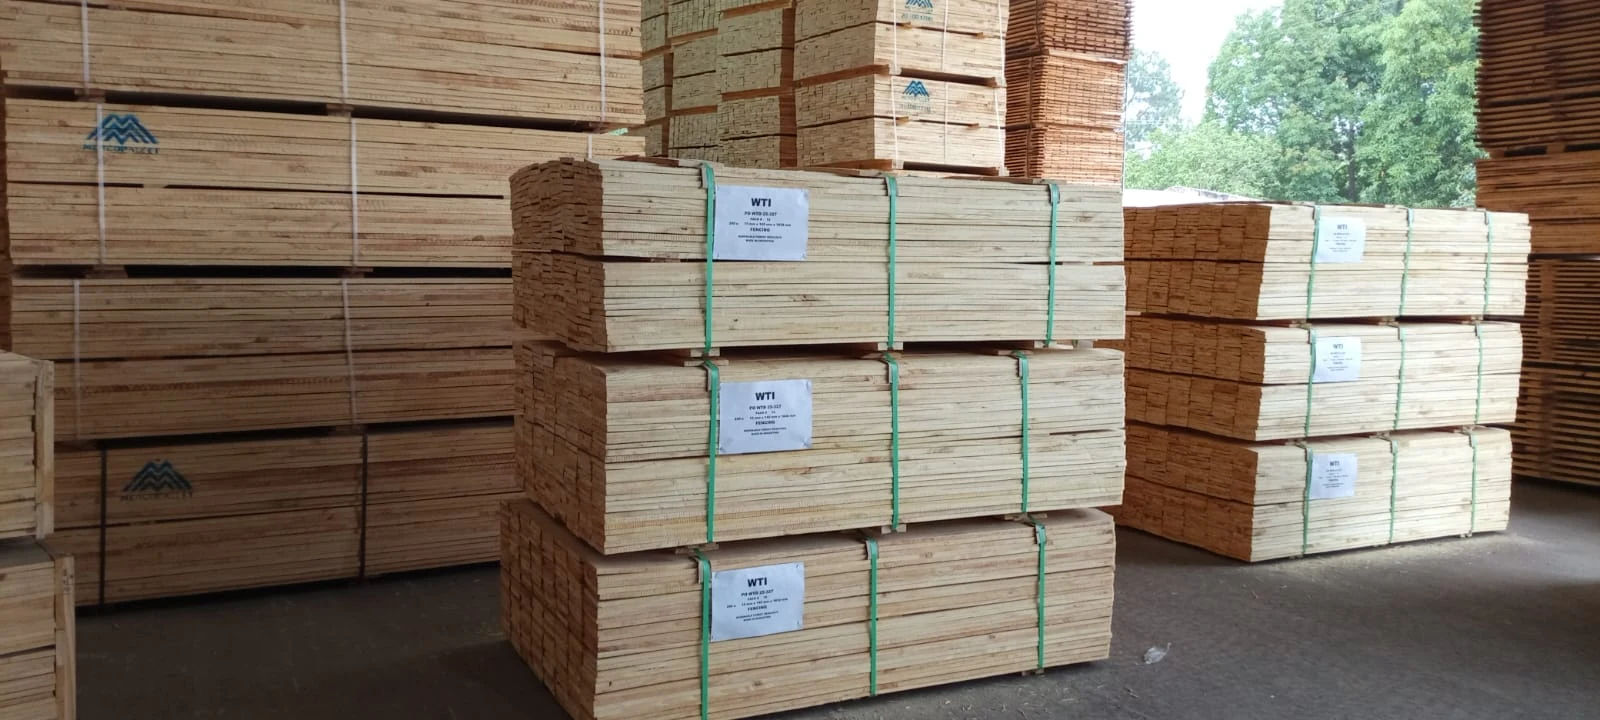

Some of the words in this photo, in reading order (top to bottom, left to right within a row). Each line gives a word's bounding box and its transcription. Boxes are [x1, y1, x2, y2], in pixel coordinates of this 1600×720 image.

[751, 198, 772, 207] WTI
[755, 391, 775, 401] WTI
[747, 577, 768, 587] WTI
